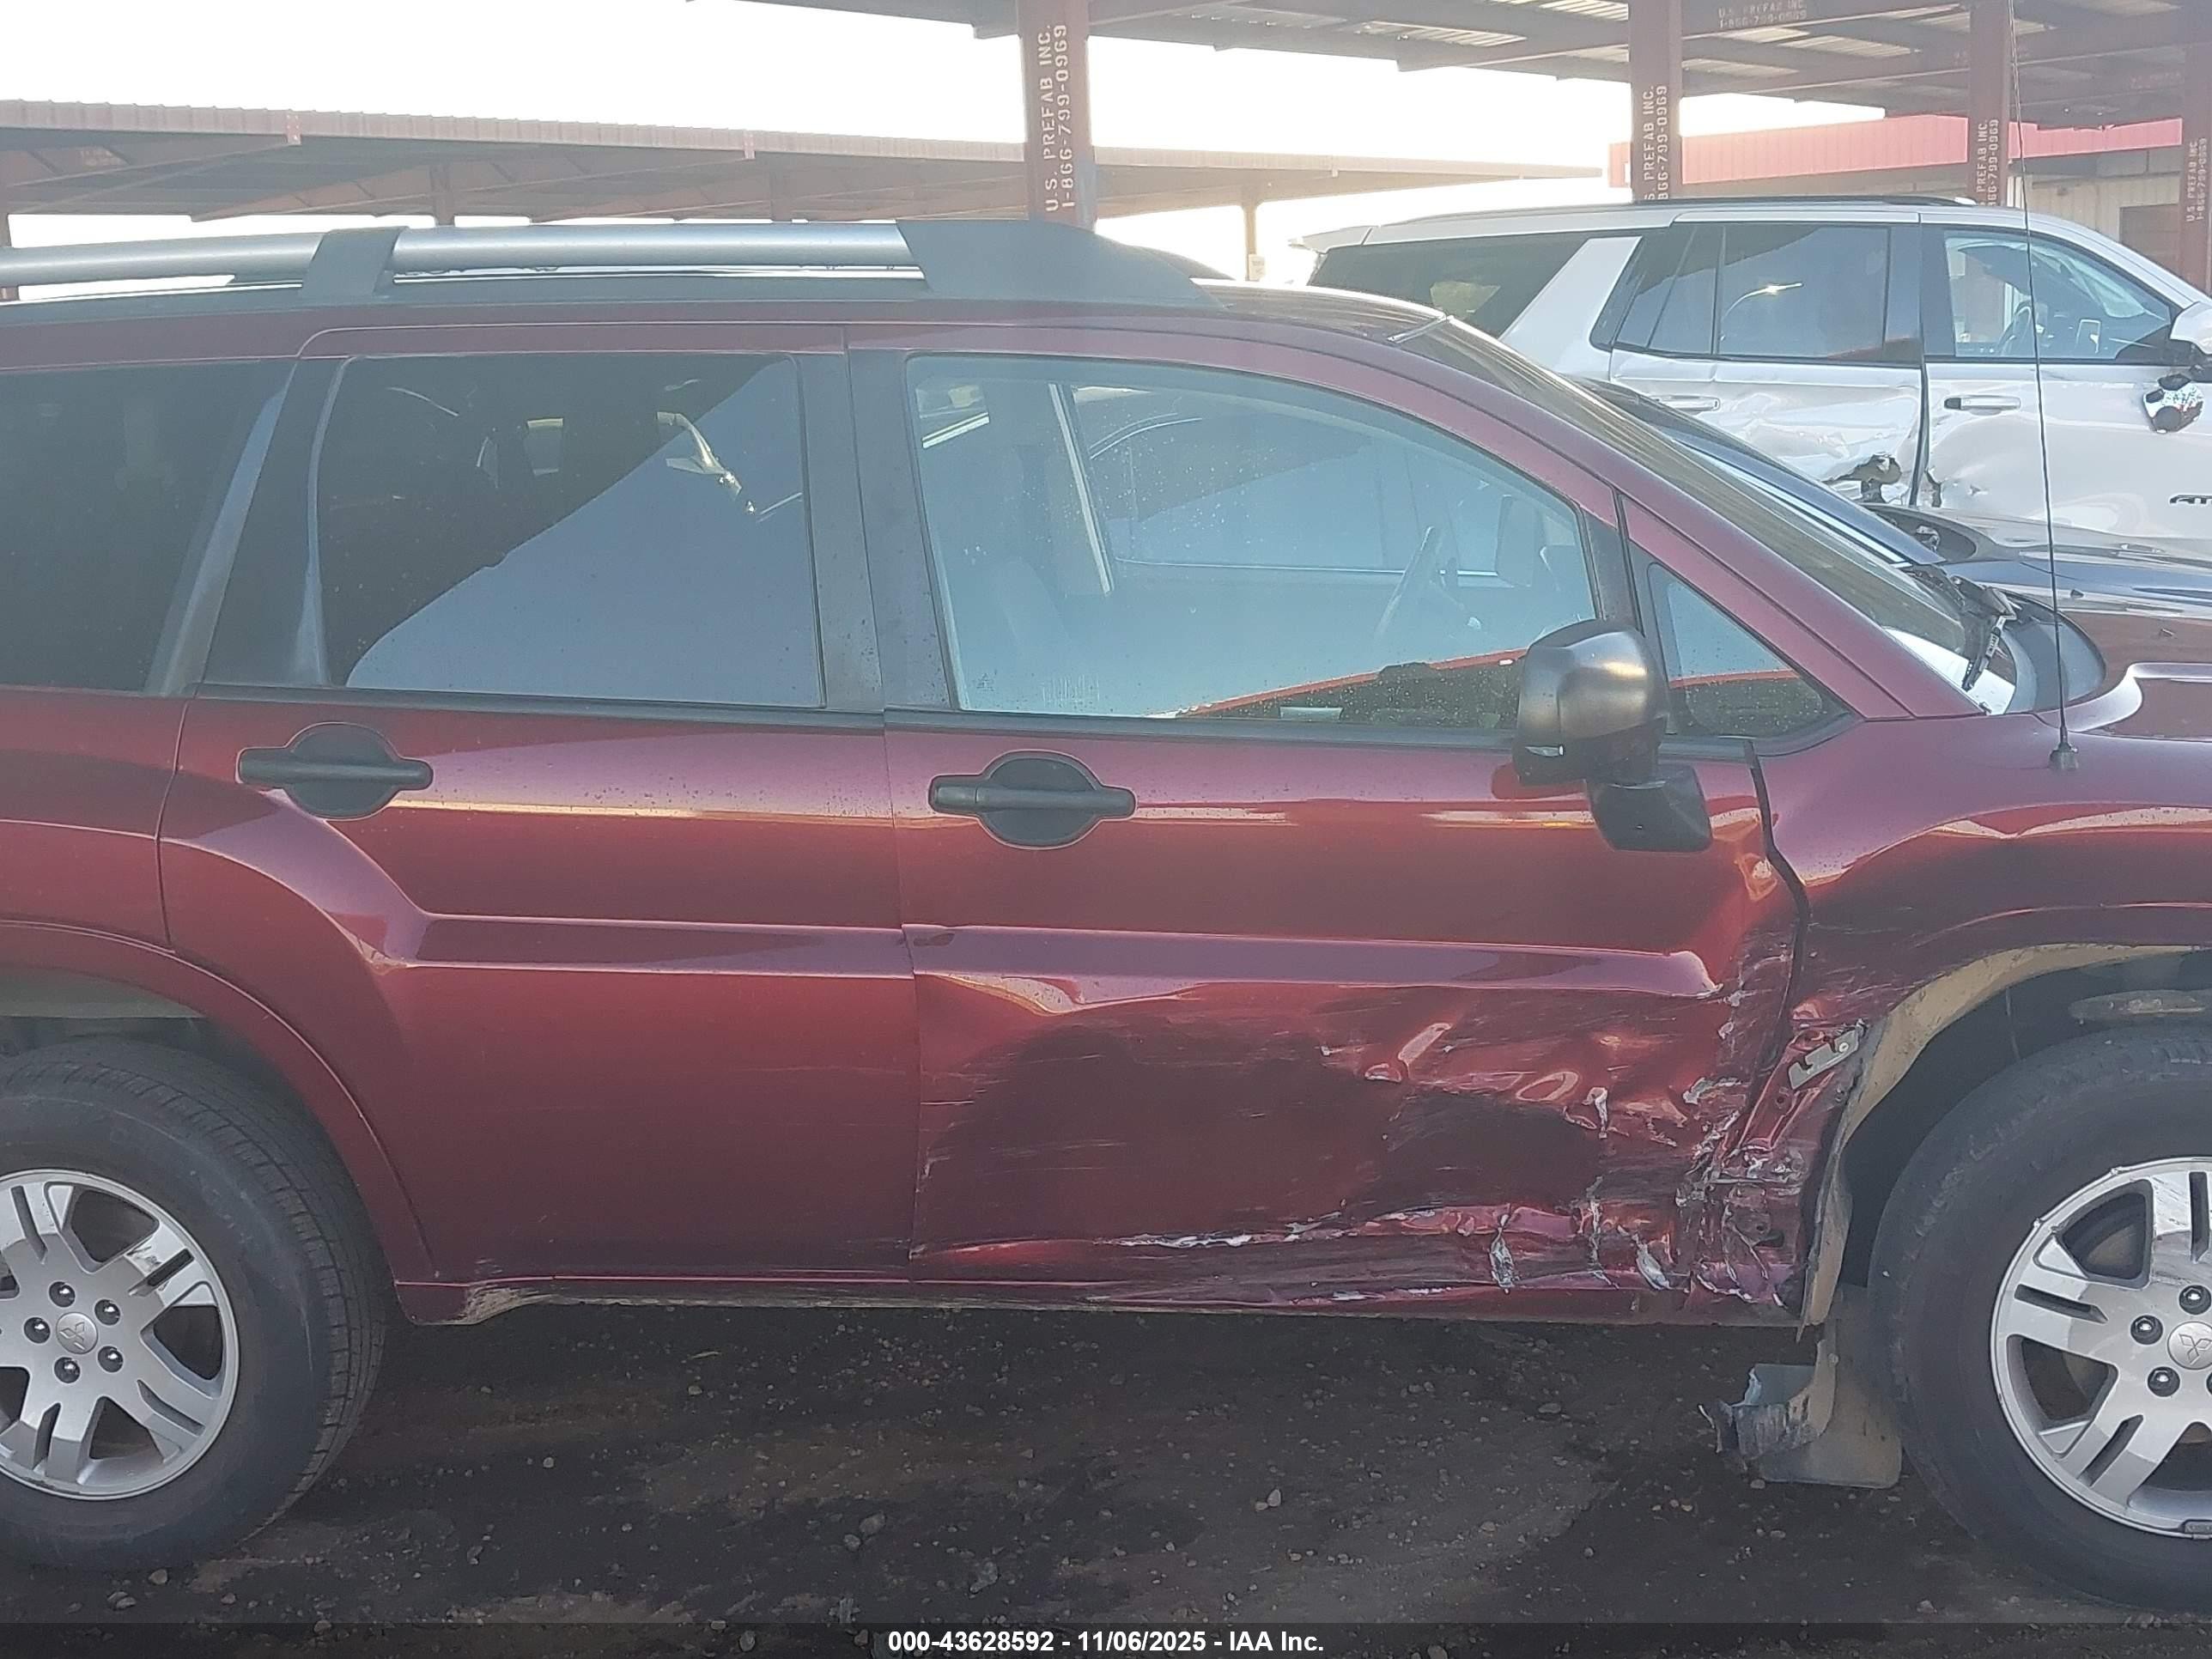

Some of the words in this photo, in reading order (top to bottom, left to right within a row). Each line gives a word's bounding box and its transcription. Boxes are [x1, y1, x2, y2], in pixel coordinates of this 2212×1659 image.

[1037, 25, 1052, 65] INC.
[1039, 76, 1056, 160] PREFAB
[1054, 24, 1075, 207] 1-866-799-0969
[1642, 85, 1655, 115] INC.
[1643, 122, 1656, 180] PREFAB
[1977, 147, 1987, 192] PREFAB
[1045, 172, 1059, 211] U.S.
